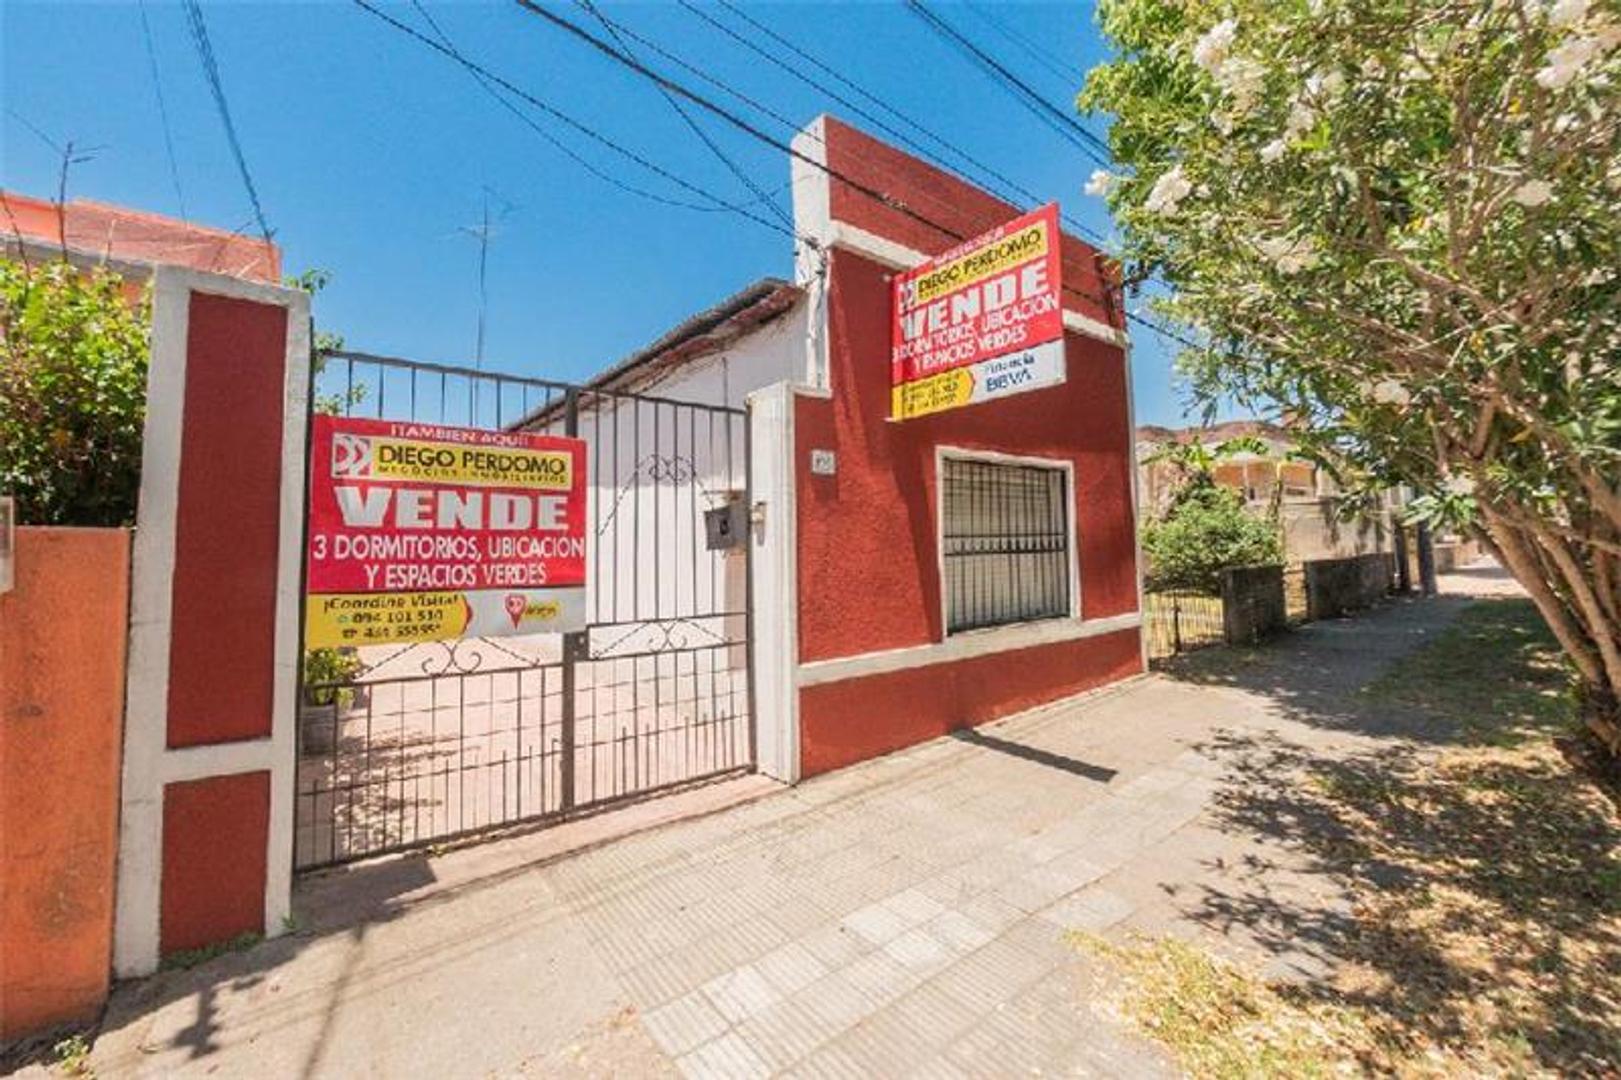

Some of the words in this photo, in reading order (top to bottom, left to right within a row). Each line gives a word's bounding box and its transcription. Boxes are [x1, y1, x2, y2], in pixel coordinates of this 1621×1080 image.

[918, 265, 960, 292] DIEGO
[963, 229, 1041, 274] PERDOMO
[901, 260, 1047, 339] VENDE
[987, 368, 1032, 392] BBVA
[379, 445, 455, 468] DIEGO
[462, 451, 566, 475] PERDOMO
[333, 486, 569, 530] VENDE
[313, 535, 327, 560] 3
[334, 535, 482, 561] DORMITORIOS,
[364, 565, 379, 588] Y
[385, 564, 477, 588] ESPACIOS
[482, 562, 547, 584] VERDES
